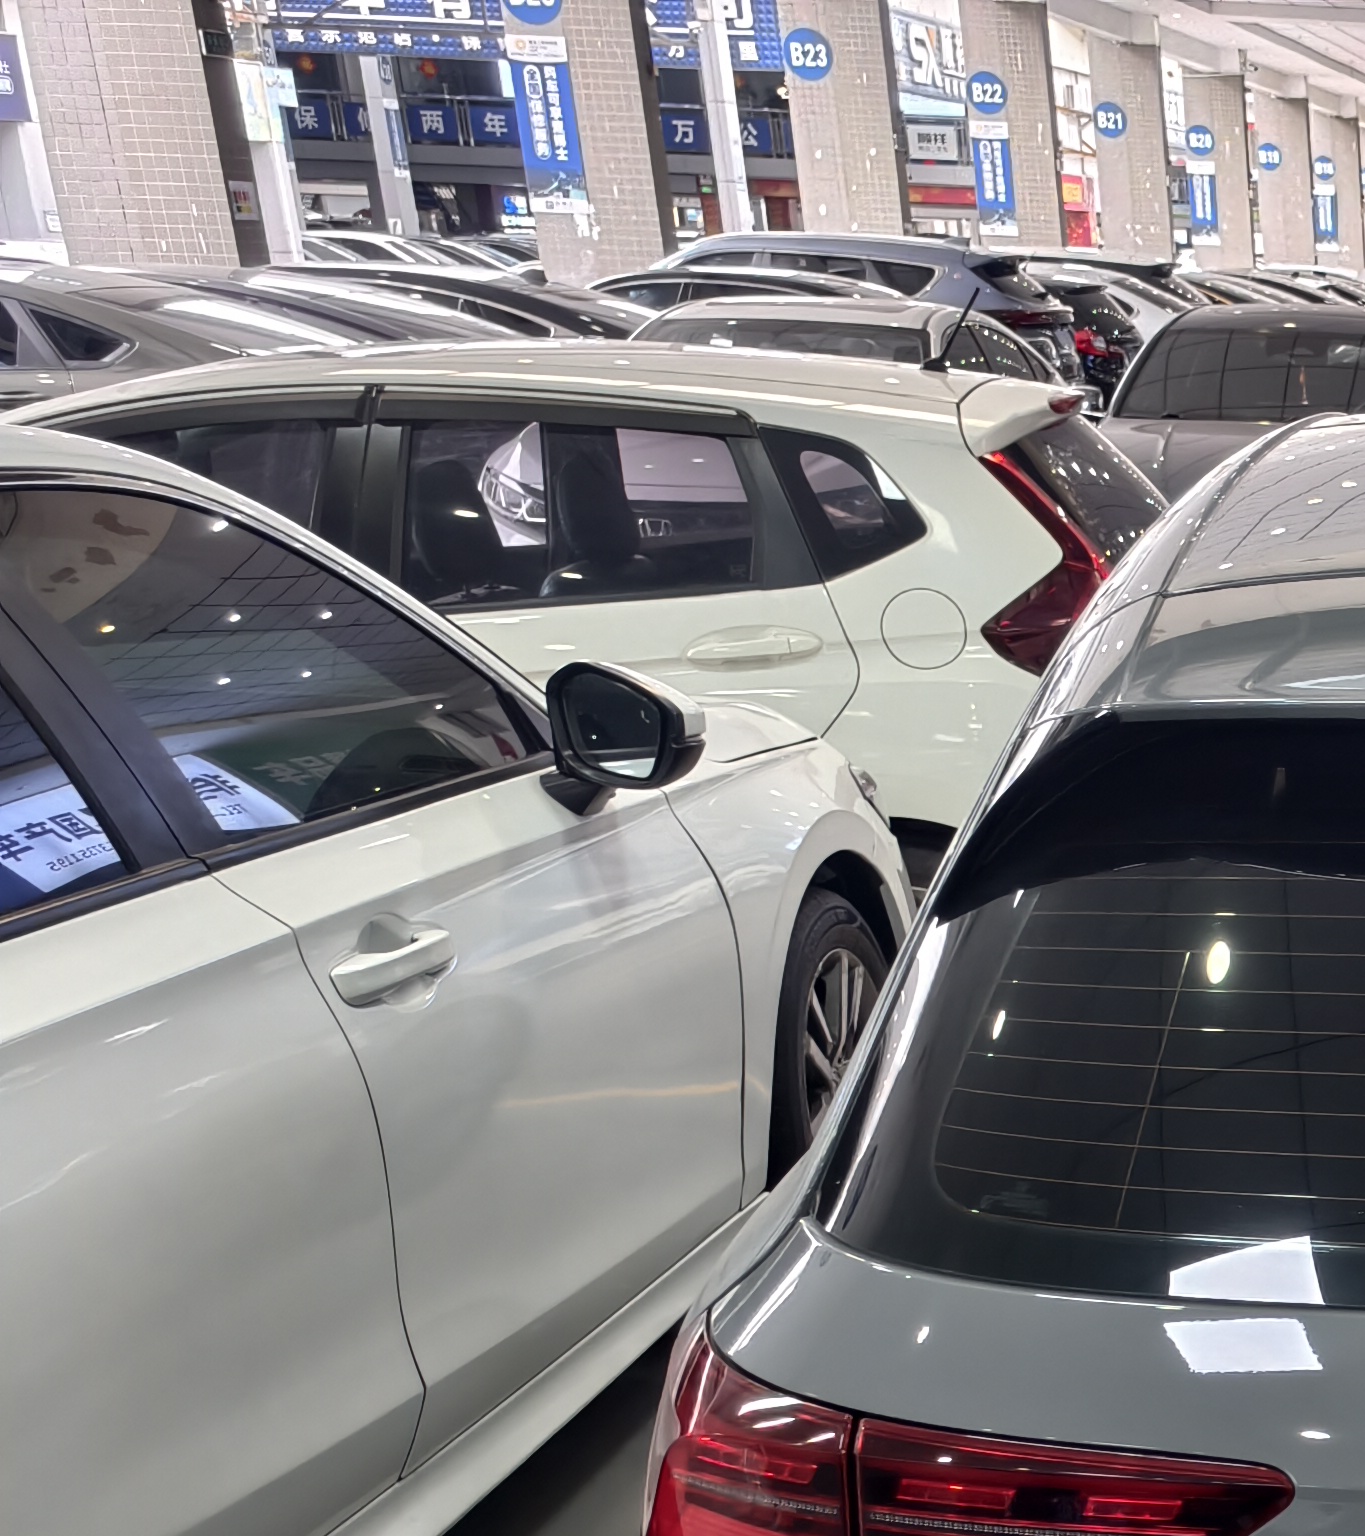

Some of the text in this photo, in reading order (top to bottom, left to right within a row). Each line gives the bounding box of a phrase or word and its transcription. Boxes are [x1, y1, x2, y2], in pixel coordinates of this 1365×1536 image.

[789, 41, 828, 68] B23
[972, 82, 1004, 104] B22
[484, 112, 508, 137] 年
[672, 120, 695, 144] 万
[1097, 111, 1122, 130] B21
